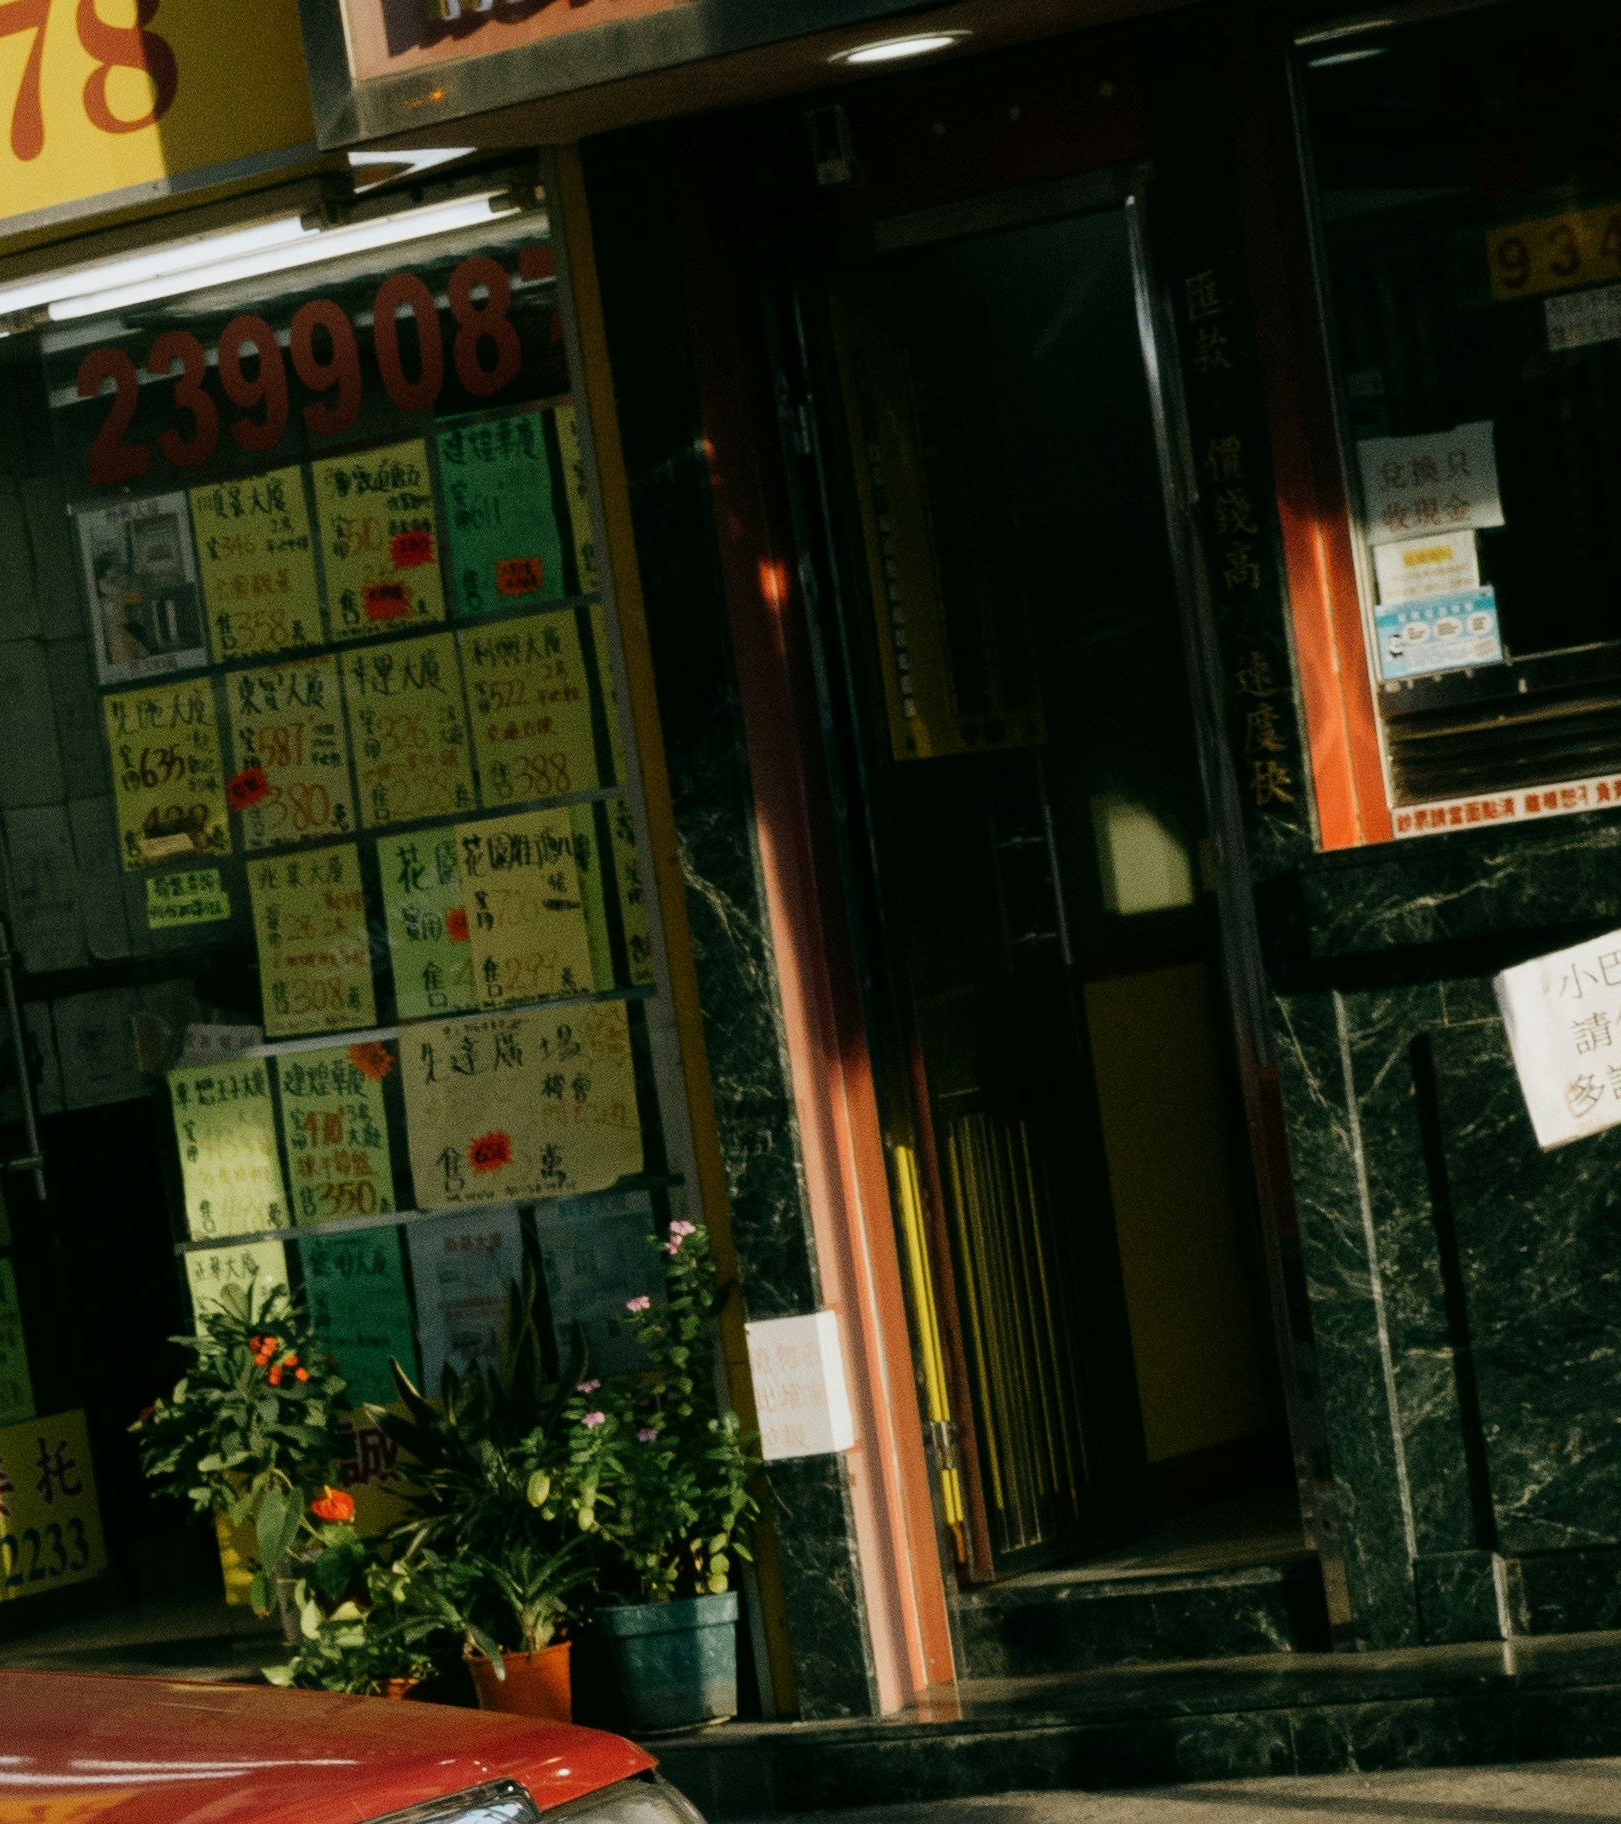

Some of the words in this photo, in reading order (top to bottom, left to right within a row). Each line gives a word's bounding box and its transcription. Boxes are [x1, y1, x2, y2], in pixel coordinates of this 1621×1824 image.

[77, 247, 565, 485] 239908
[139, 745, 186, 788] 635
[1570, 1008, 1621, 1056] 請
[317, 1180, 378, 1216] 350
[1, 1517, 91, 1588] 2233
